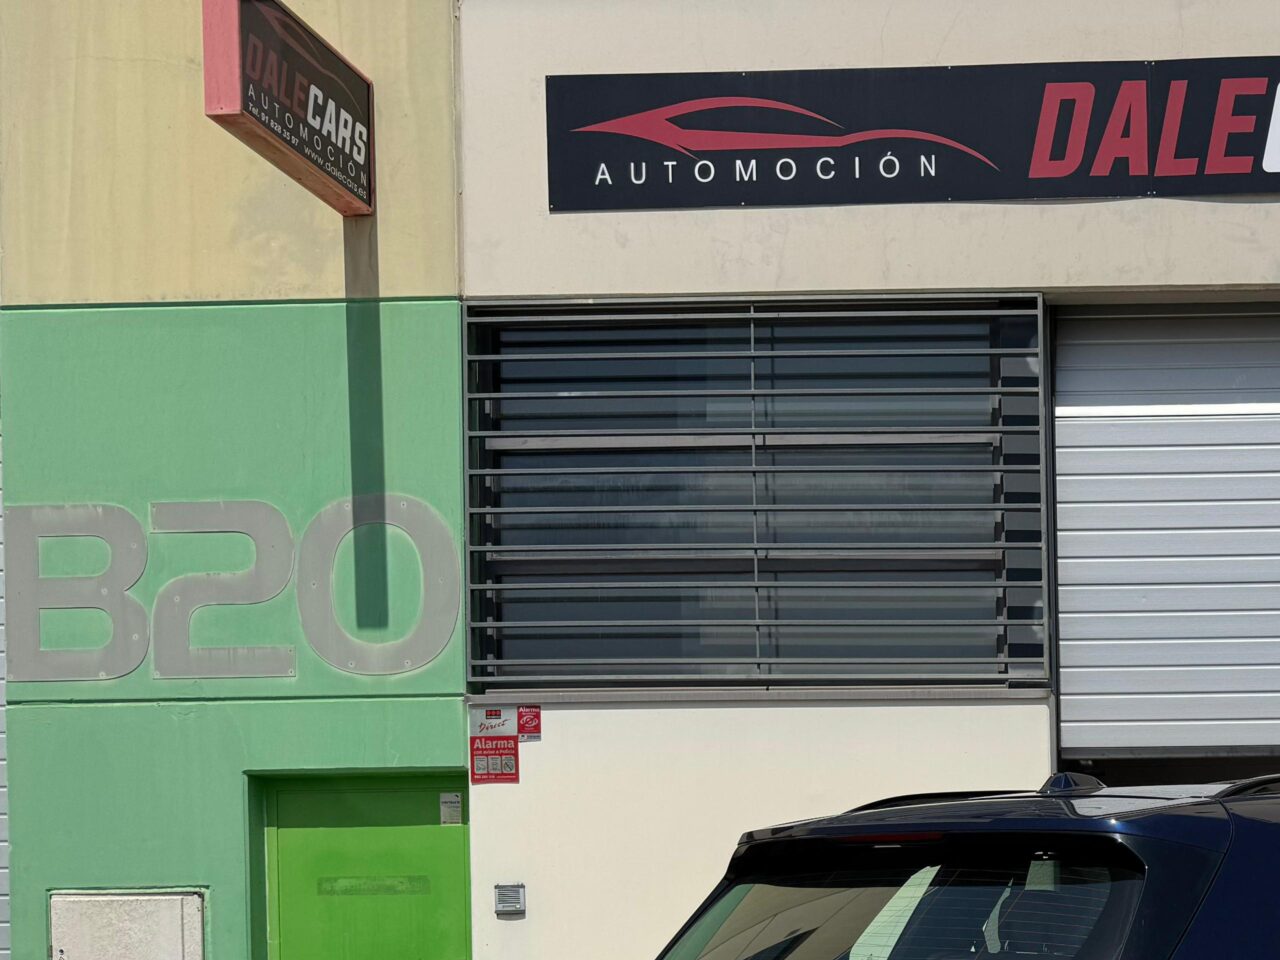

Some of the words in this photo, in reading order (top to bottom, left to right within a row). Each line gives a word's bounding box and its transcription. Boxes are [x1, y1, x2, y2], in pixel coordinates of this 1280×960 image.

[246, 32, 368, 166] DALECARS
[248, 83, 367, 187] AUTOMOCIÓN
[248, 102, 260, 118] Tel.
[260, 113, 269, 124] 91
[270, 118, 282, 134] 828
[282, 129, 291, 140] 35
[303, 144, 367, 199] www.dalecars.es
[594, 151, 937, 185] AUTOMOCIÓN
[4, 493, 461, 683] B20
[473, 738, 515, 749] Alarma
